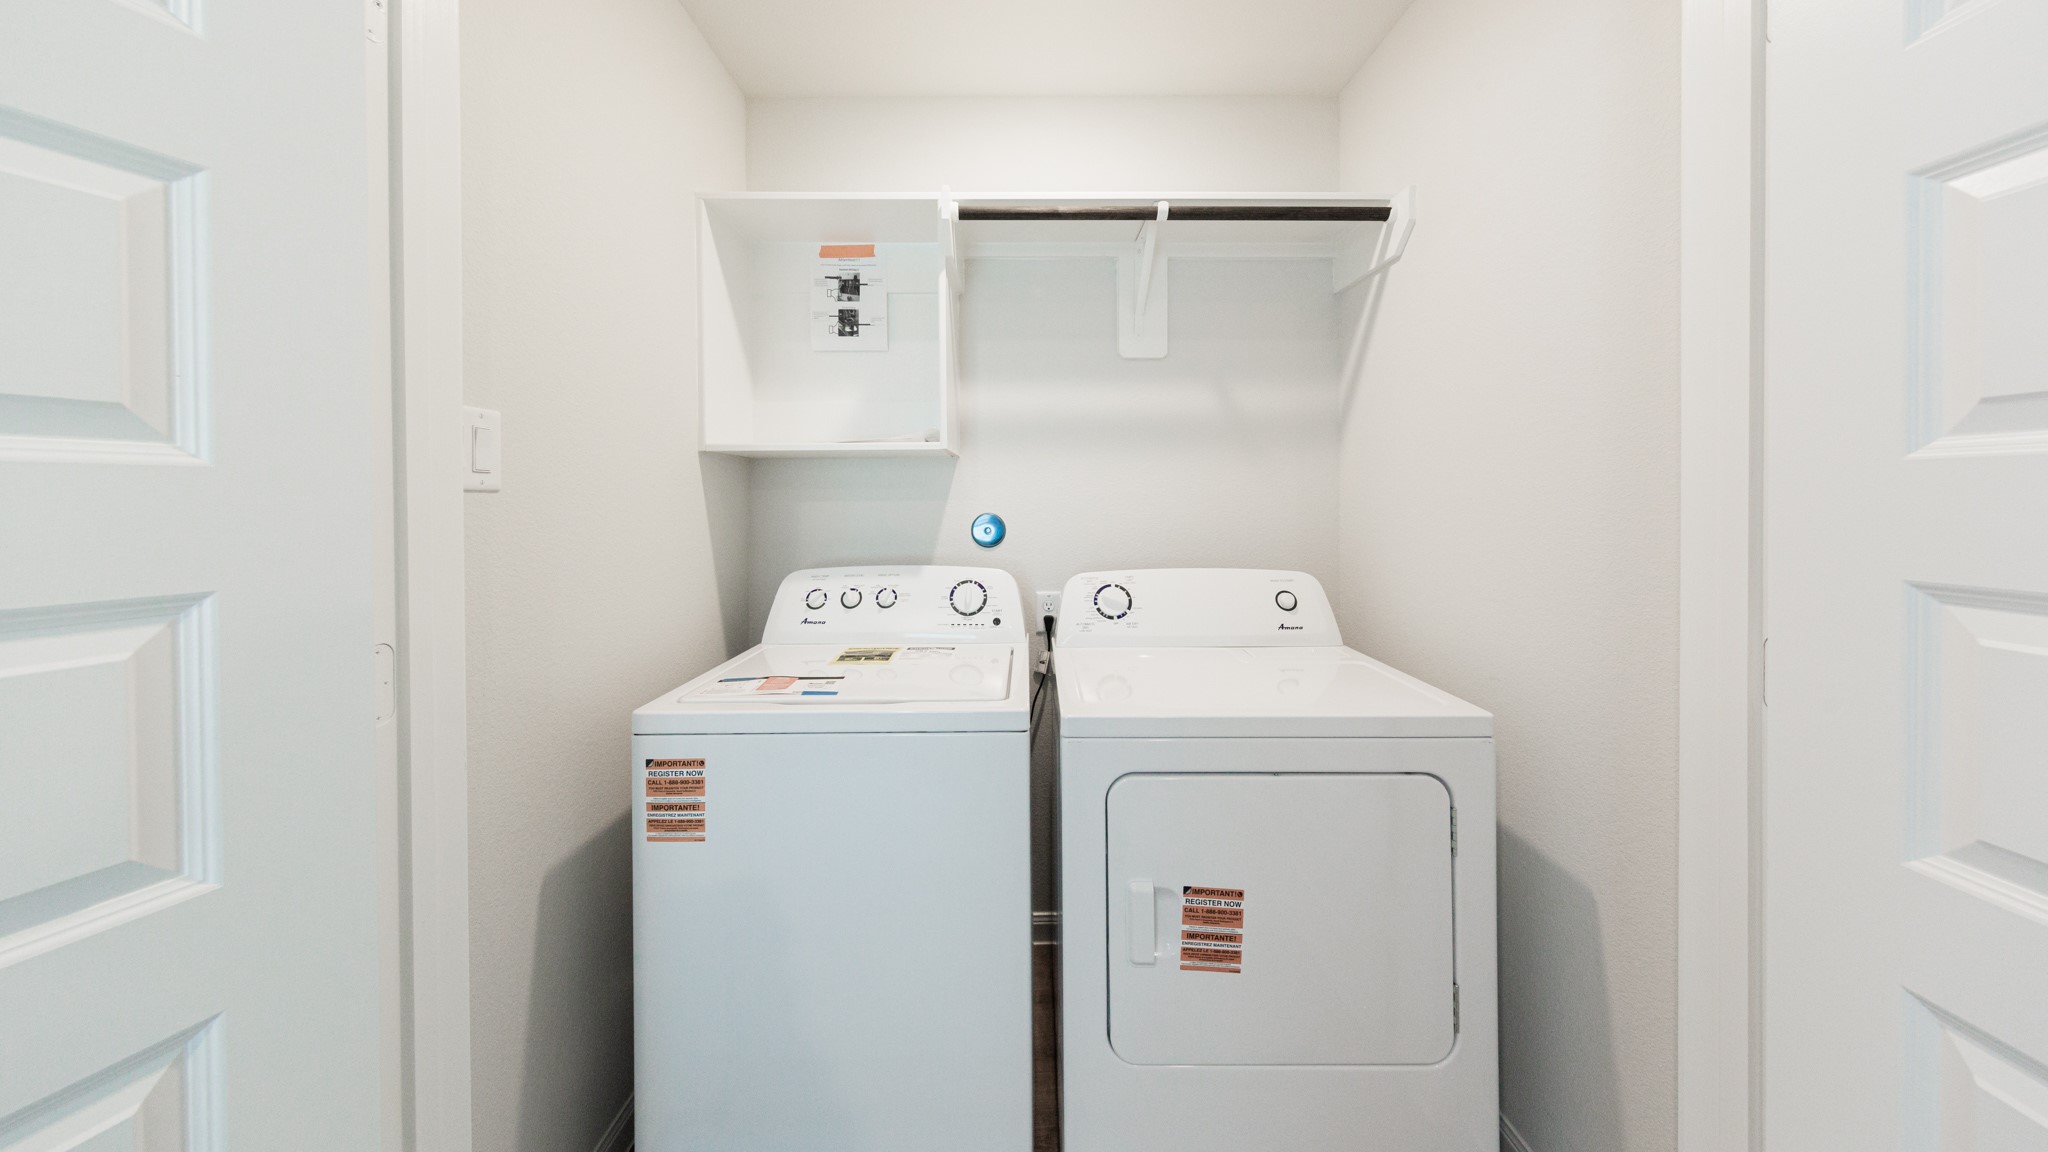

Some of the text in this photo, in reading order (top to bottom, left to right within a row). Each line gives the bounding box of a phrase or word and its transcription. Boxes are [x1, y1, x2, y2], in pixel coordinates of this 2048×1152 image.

[1192, 889, 1237, 897] IMPORTANT!
[1185, 898, 1222, 906] REGISTER
[1186, 933, 1236, 942] IMPORTANTE!
